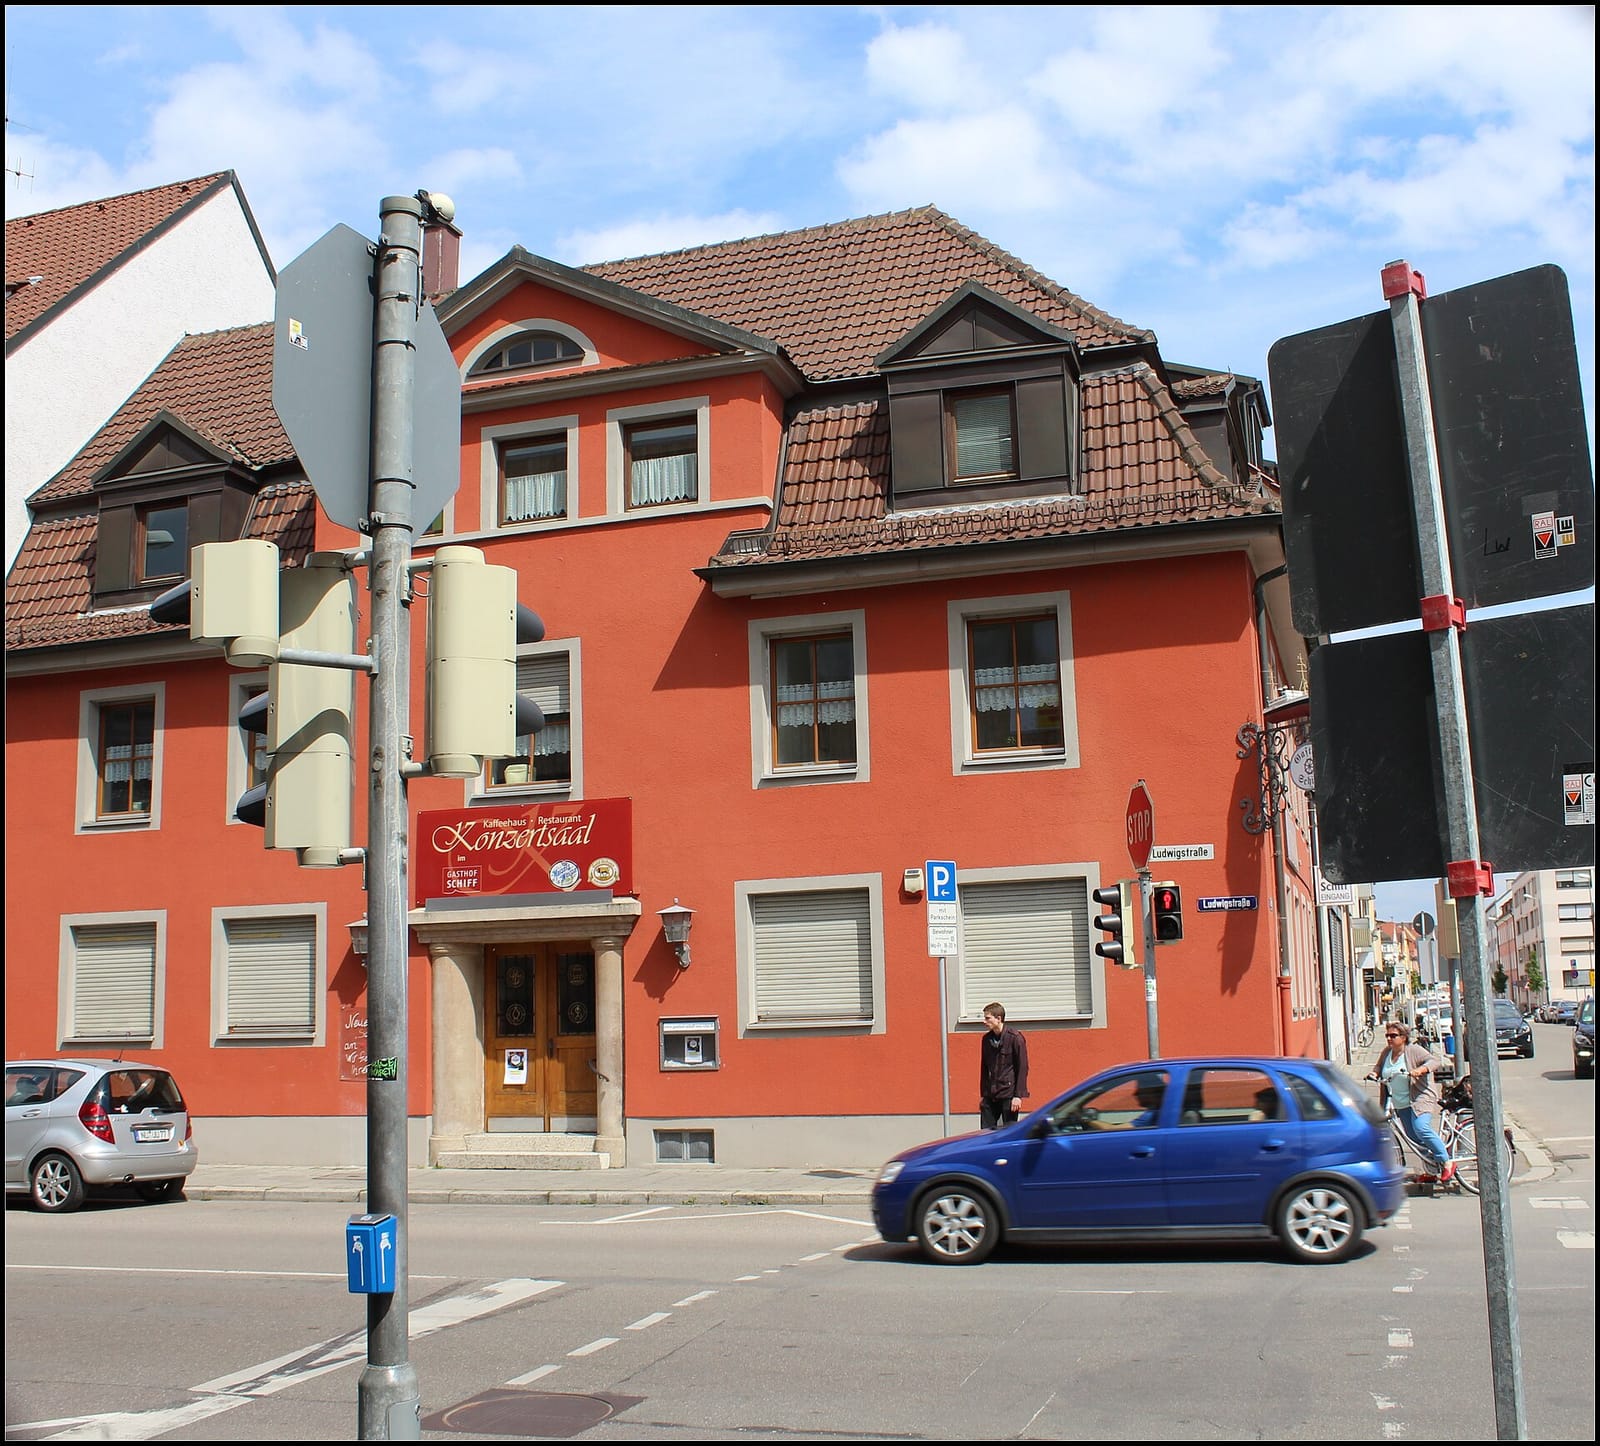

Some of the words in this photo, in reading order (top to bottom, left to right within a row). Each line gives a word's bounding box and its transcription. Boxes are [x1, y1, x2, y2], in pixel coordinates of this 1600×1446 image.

[483, 818, 527, 828] Kaffeehaus
[538, 814, 582, 826] Restaurant
[1128, 809, 1150, 845] STOP
[432, 813, 597, 853] Konzertsaal
[457, 854, 466, 862] im
[1152, 846, 1209, 859] Ludwigstraße
[447, 869, 479, 879] GASTHOF
[446, 879, 479, 889] SCHIFF
[933, 866, 950, 897] P
[1202, 898, 1251, 910] Ludwigstraße
